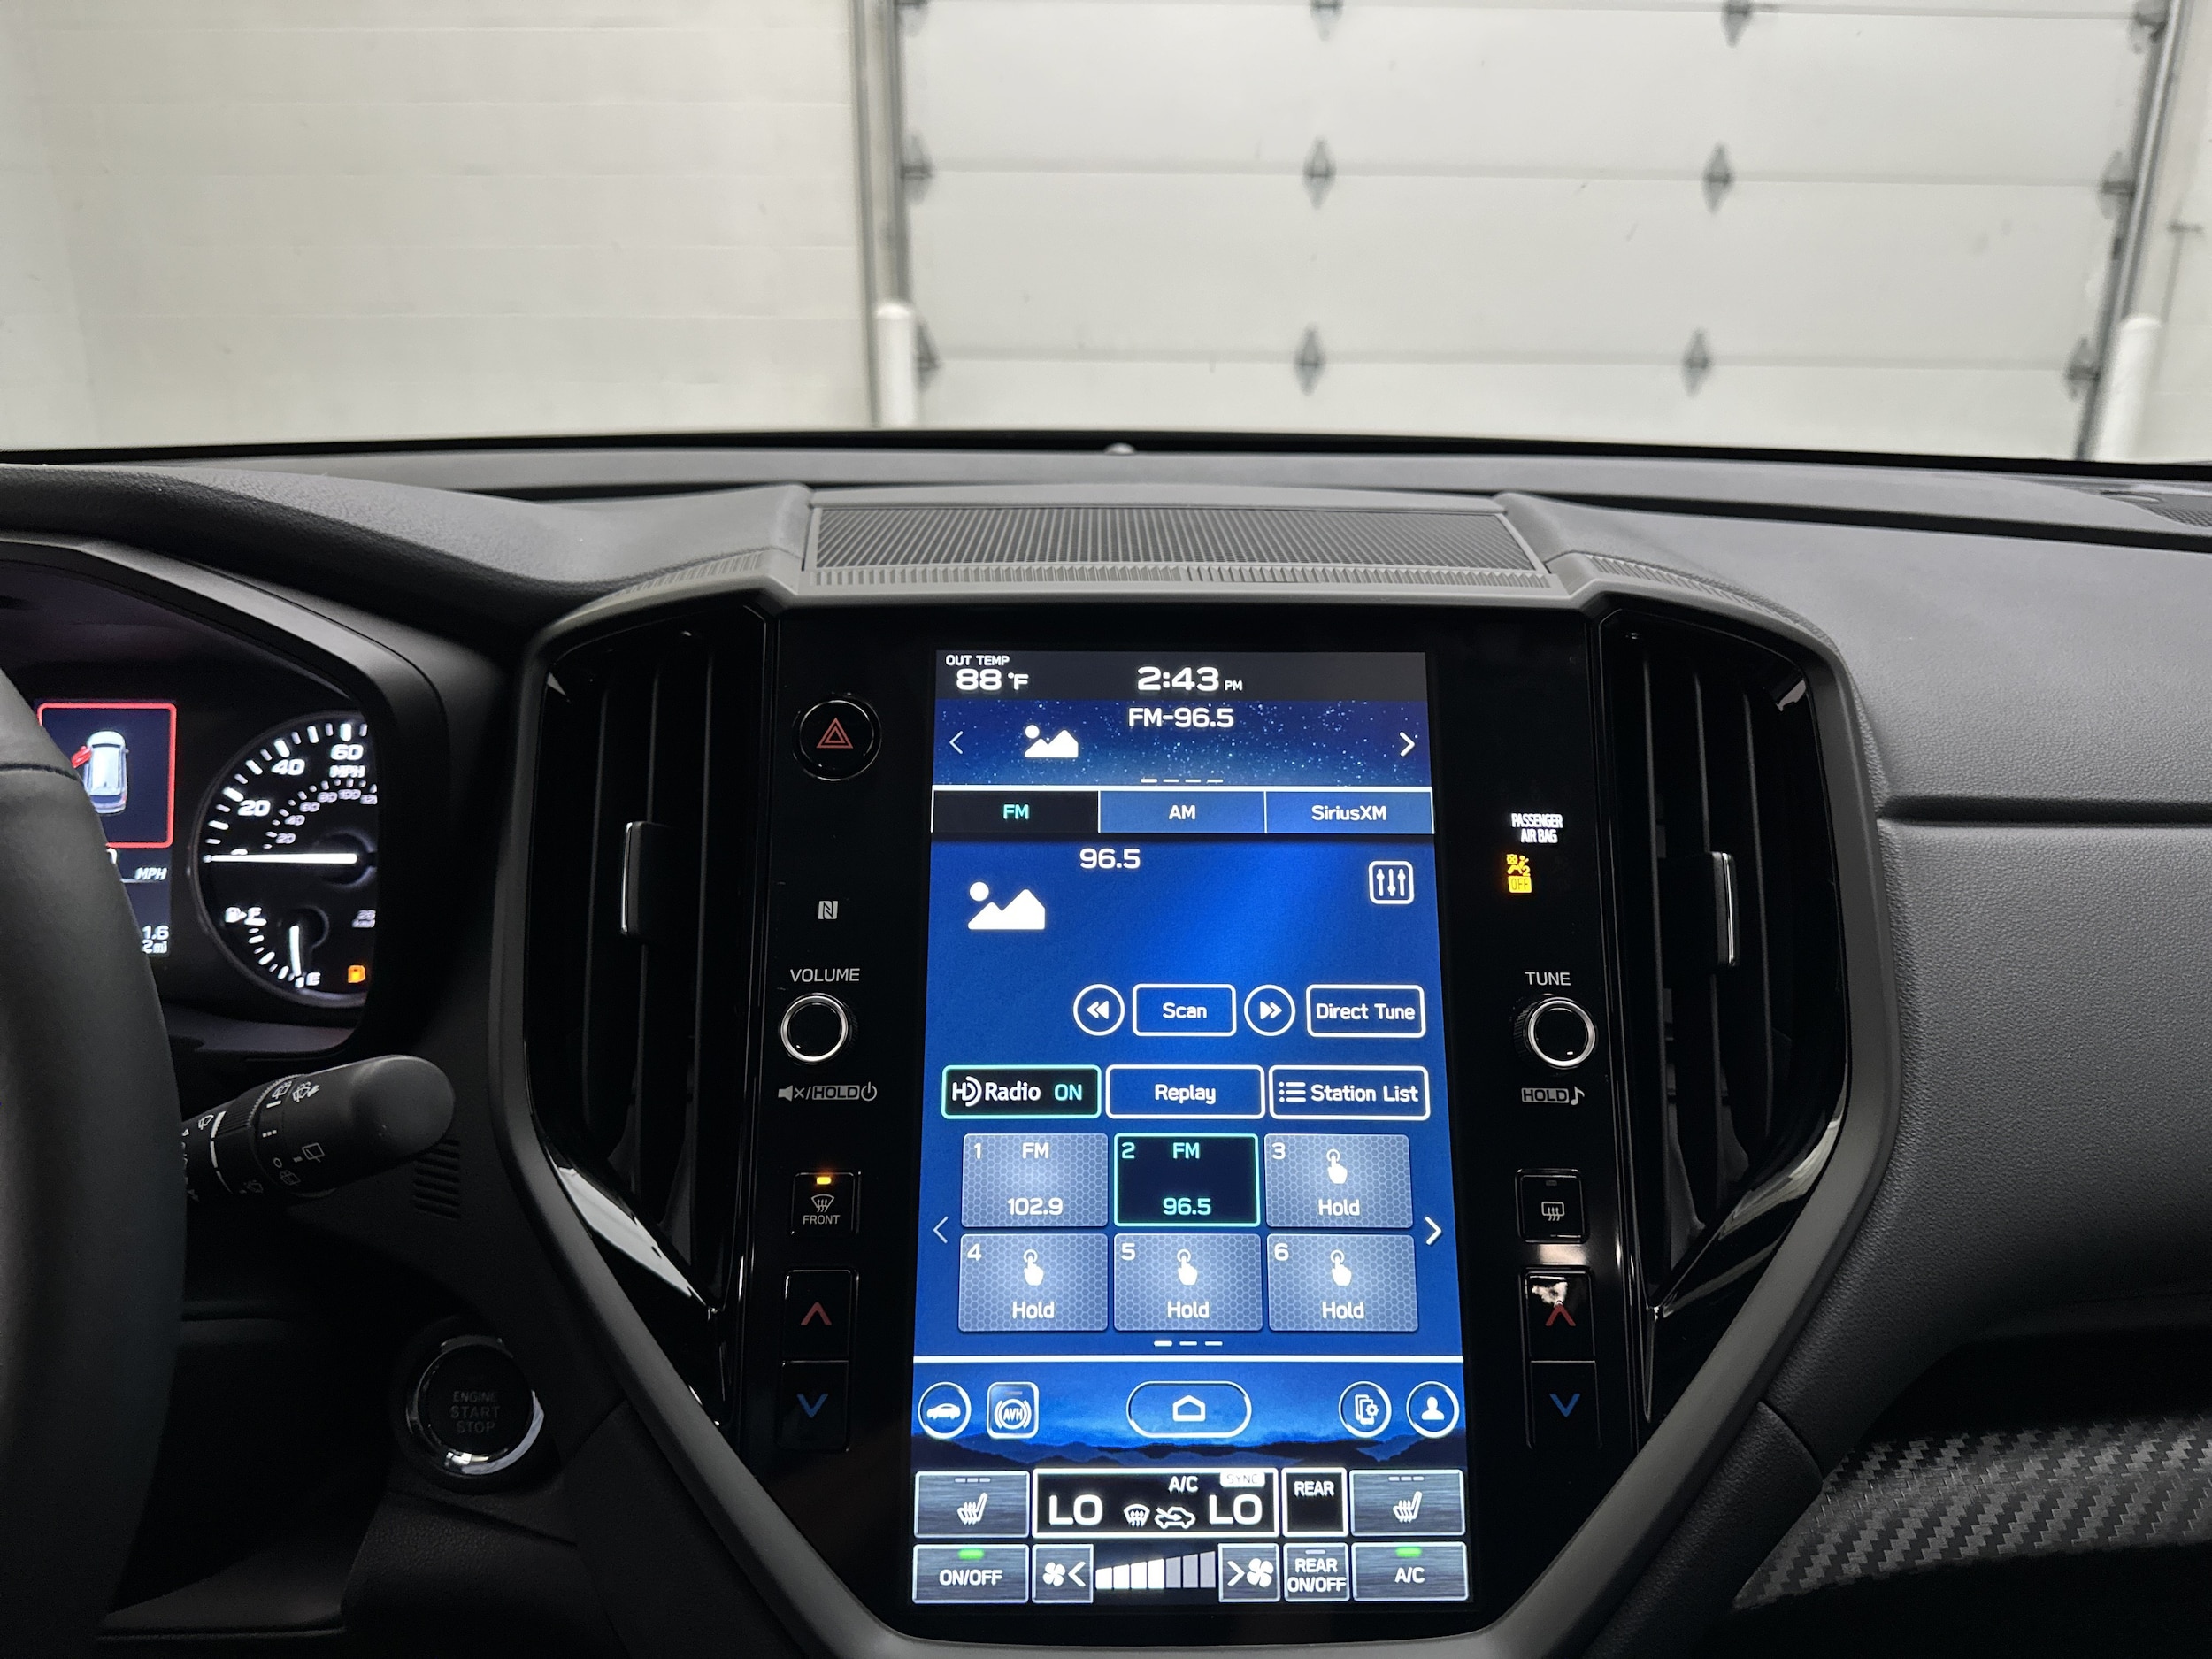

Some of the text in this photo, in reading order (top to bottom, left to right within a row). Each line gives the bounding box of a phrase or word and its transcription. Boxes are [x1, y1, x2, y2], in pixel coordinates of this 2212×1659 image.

[945, 654, 1010, 666] OUT TEMP
[956, 668, 1002, 691] 88
[1137, 666, 1243, 692] 2:43 PM
[1128, 707, 1234, 728] FM-96.5
[330, 744, 364, 760] 60
[271, 759, 305, 775] 40
[329, 765, 365, 778] MPH
[237, 799, 271, 817] 20
[1002, 803, 1030, 820] FM
[1168, 804, 1196, 820] AM
[1310, 804, 1387, 822] SiriusXM
[1510, 813, 1564, 828] PASSENGER
[1520, 828, 1558, 843] AIR BAG
[1079, 848, 1141, 869] 96.5
[134, 866, 167, 881] MPH
[1510, 877, 1529, 891] OFF
[789, 967, 861, 983] VOLUME
[1524, 971, 1571, 986] TUNE
[1161, 1002, 1209, 1020] Scan
[1316, 1002, 1417, 1021] Direct Tune
[812, 1086, 858, 1101] HOLD
[984, 1080, 1041, 1102] Radio
[1054, 1083, 1082, 1102] ON
[1155, 1083, 1217, 1105] Replay
[1310, 1084, 1419, 1102] Station List
[1523, 1088, 1568, 1103] HOLD
[973, 1142, 983, 1160] 1
[1021, 1142, 1050, 1160] FM
[1121, 1141, 1136, 1159] 2
[1172, 1142, 1200, 1159] FM
[1271, 1142, 1287, 1160] 3
[1006, 1196, 1064, 1217] 102.9
[1163, 1197, 1211, 1216] 96.5
[1317, 1198, 1362, 1217] Hold
[803, 1214, 841, 1225] FRONT
[966, 1243, 983, 1262] 4
[1120, 1242, 1137, 1262] 5
[1273, 1242, 1290, 1262] 6
[1011, 1300, 1056, 1320] Hold
[1166, 1300, 1210, 1320] Hold
[1321, 1301, 1365, 1320] Hold
[453, 1390, 496, 1402] ENGINE
[450, 1405, 501, 1418] START
[1002, 1407, 1023, 1422] AVH
[456, 1420, 495, 1433] STOP
[1168, 1475, 1199, 1494] A/C
[1225, 1472, 1260, 1486] SYNC
[1294, 1479, 1335, 1497] REAR
[1048, 1494, 1103, 1526] LO
[1209, 1493, 1263, 1526] LO
[1294, 1557, 1338, 1574] REAR
[939, 1568, 1003, 1587] ON/OFF
[1286, 1575, 1348, 1594] ON/OFF
[1394, 1566, 1425, 1585] A/C
